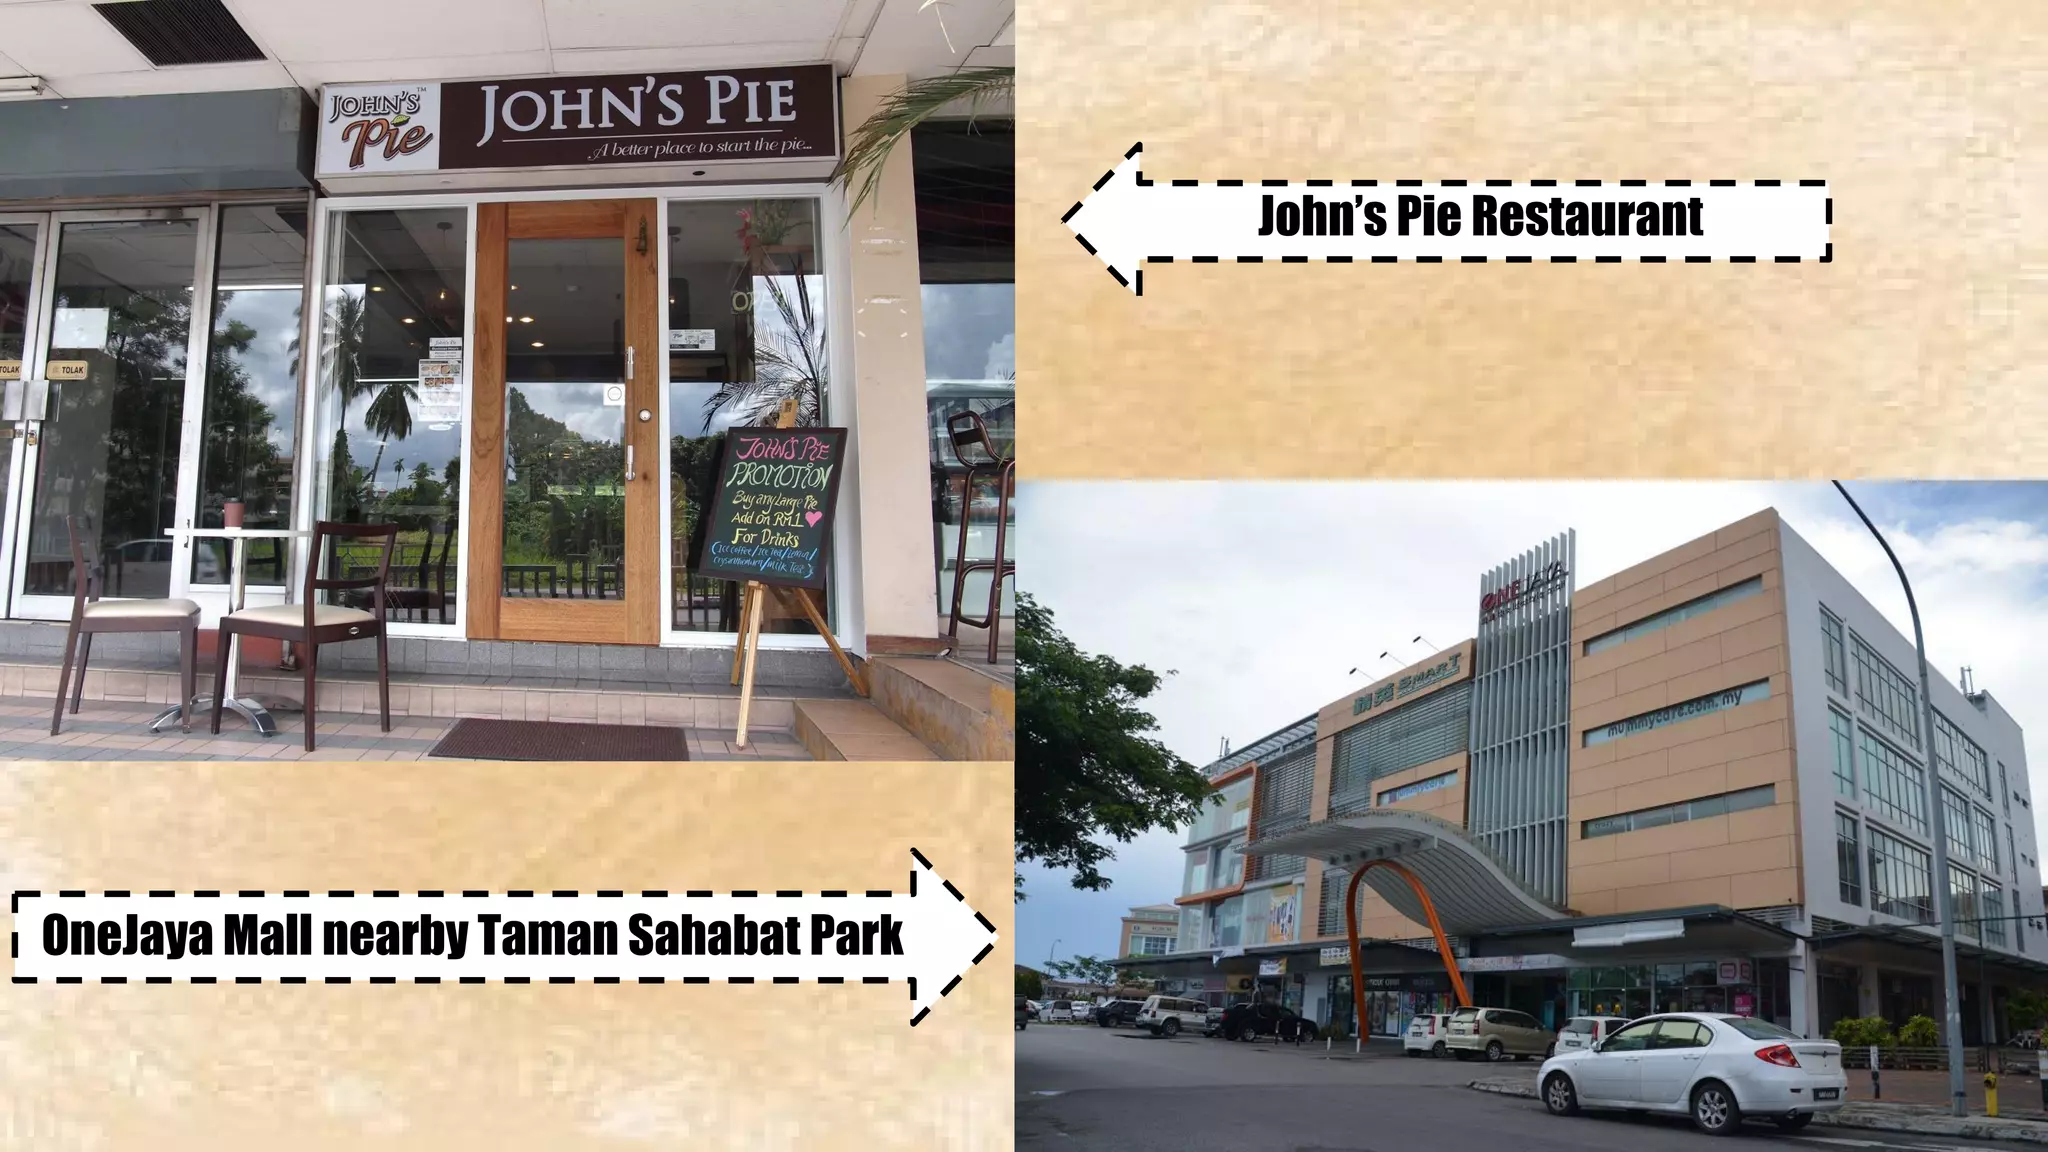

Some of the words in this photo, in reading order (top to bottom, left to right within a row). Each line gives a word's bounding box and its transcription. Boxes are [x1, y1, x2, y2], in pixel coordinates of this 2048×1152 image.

[328, 90, 420, 123] JOHN'S
[477, 76, 685, 147] JOHN'S
[705, 75, 797, 124] PIE
[341, 117, 433, 171] Pie
[587, 142, 608, 161] A
[612, 141, 653, 157] better
[654, 140, 695, 158] place
[699, 141, 714, 153] to
[716, 139, 751, 152] start
[754, 137, 777, 151] the
[62, 366, 84, 374] TOLAK
[732, 490, 756, 509] Buy
[756, 493, 777, 514] any
[774, 493, 803, 515] Large
[804, 495, 818, 510] Pie
[731, 511, 755, 524] Add
[731, 528, 758, 544] For
[761, 528, 799, 548] Drinks
